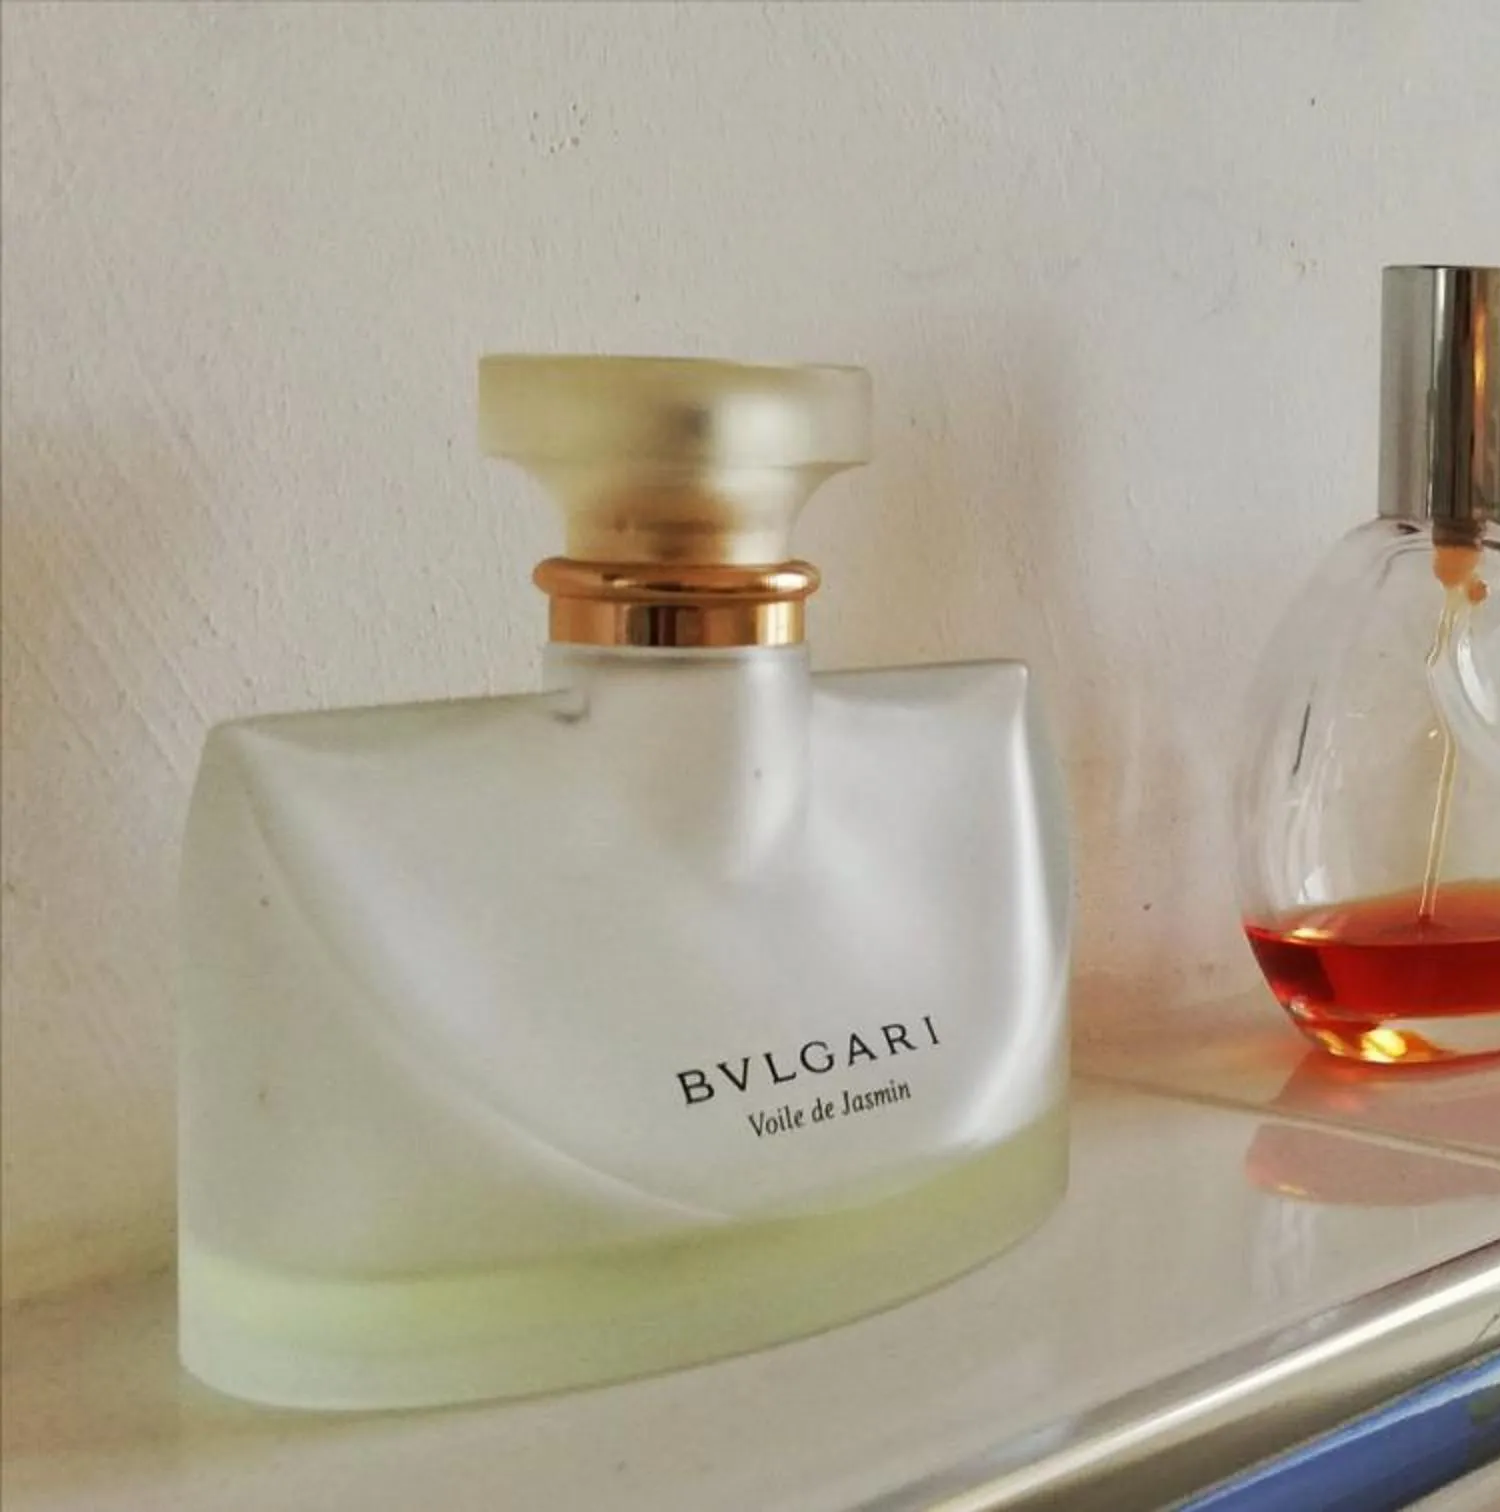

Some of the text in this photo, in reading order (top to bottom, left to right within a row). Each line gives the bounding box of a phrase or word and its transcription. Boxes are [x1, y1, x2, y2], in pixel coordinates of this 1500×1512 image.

[676, 1015, 941, 1105] BVLGARI
[748, 1079, 913, 1139] Voile de Jasmin
